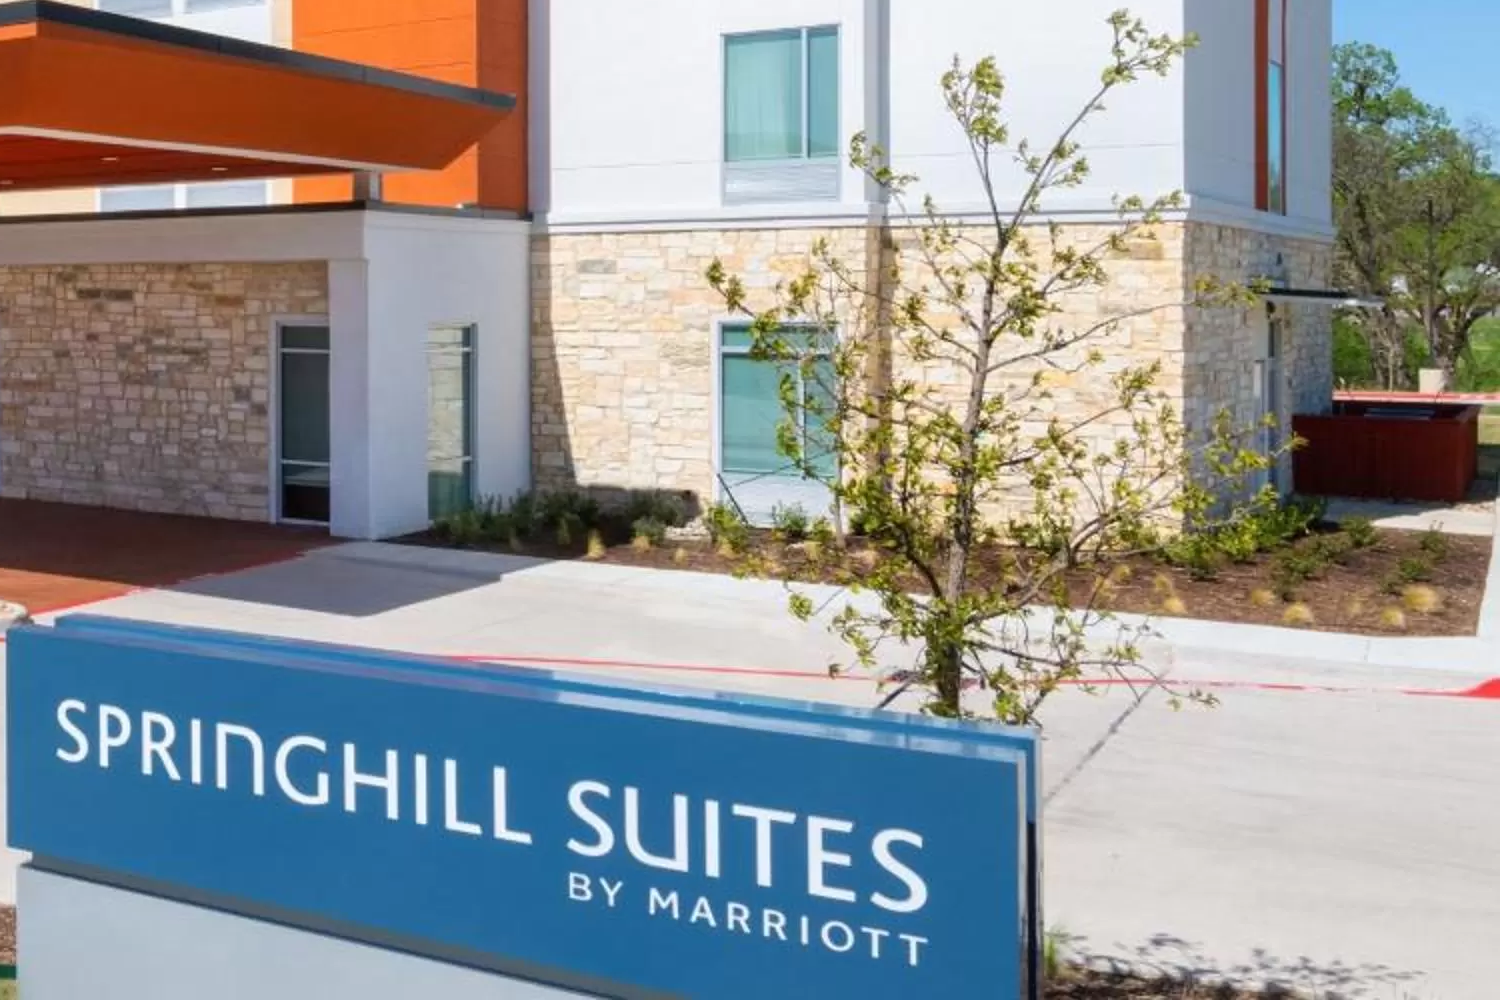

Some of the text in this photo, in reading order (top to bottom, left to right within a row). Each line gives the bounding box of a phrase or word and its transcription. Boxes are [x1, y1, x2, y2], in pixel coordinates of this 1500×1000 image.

[55, 698, 929, 913] SPRINGHILL SUITES
[568, 873, 928, 966] BY MARRIOTT
